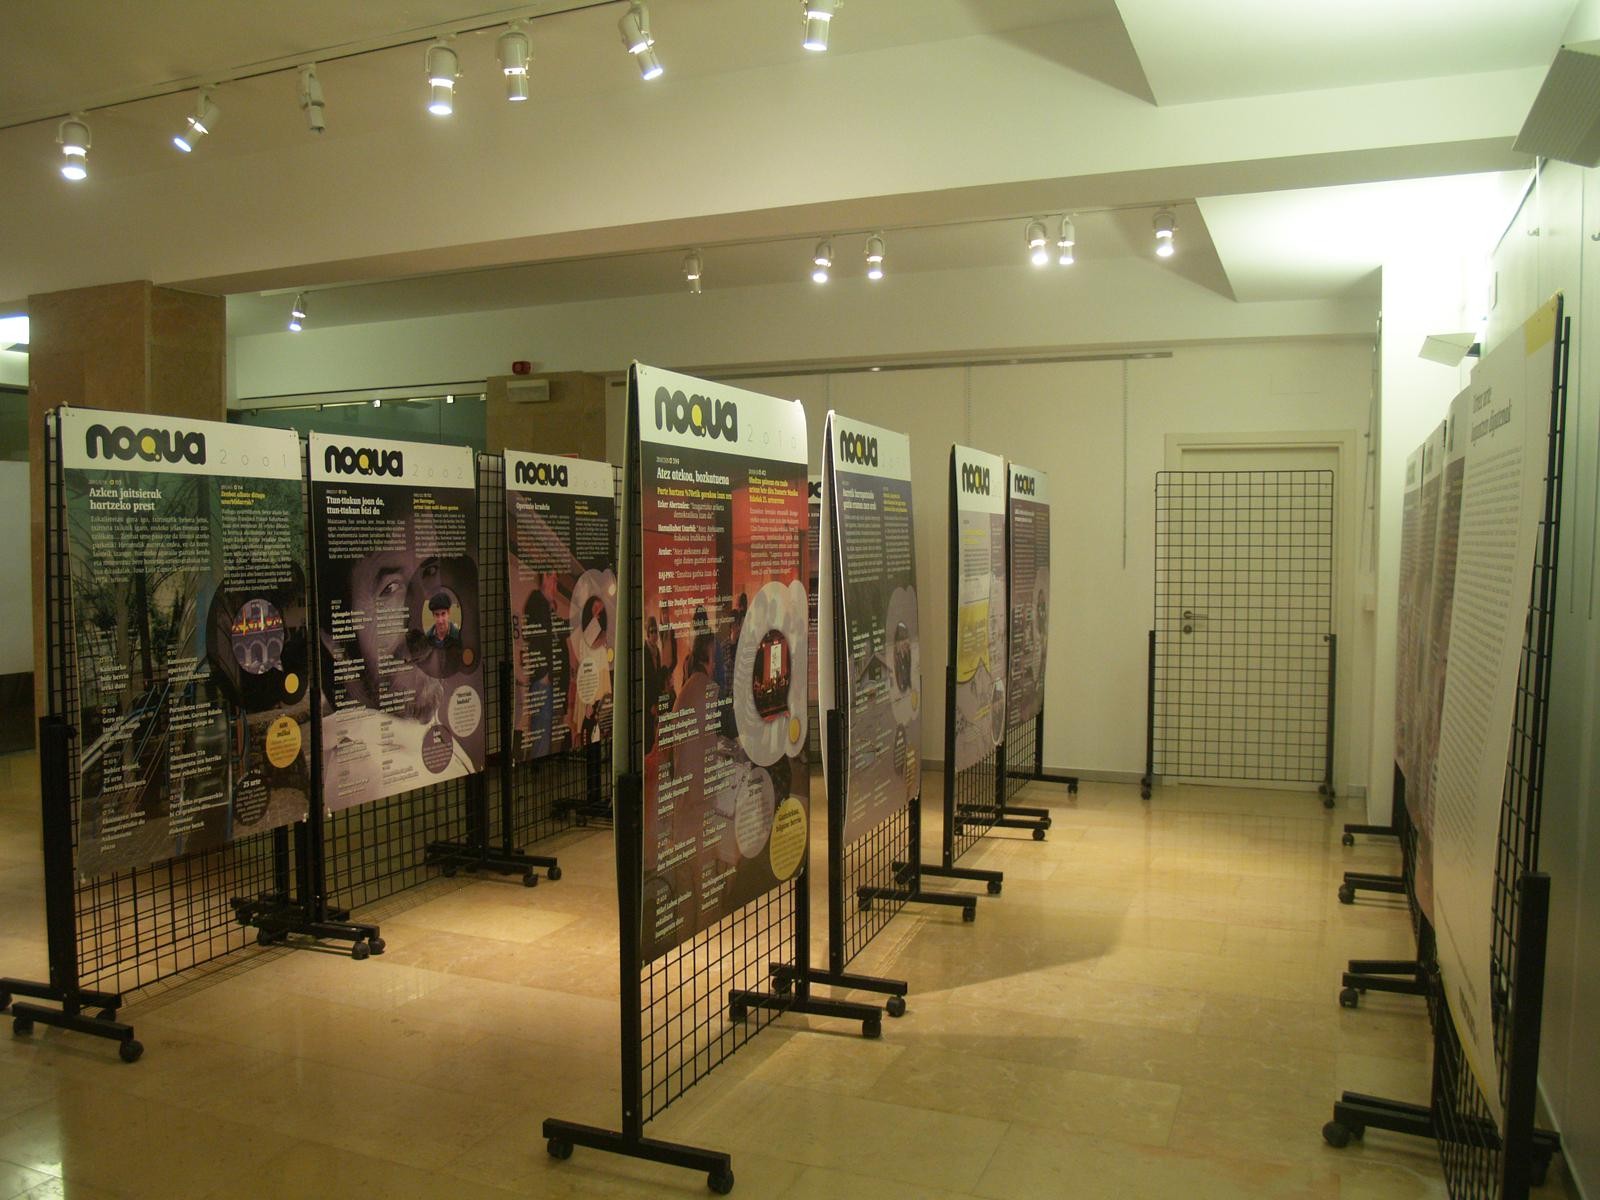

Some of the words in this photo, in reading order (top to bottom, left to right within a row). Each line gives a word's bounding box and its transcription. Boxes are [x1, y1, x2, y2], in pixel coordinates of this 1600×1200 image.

[219, 448, 287, 468] 2001
[656, 467, 671, 479] Atez
[672, 469, 695, 483] atekoa,
[89, 488, 118, 498] Azken
[119, 488, 162, 500] jaitsierak
[90, 500, 131, 511] hartzeko
[133, 502, 155, 512] prest
